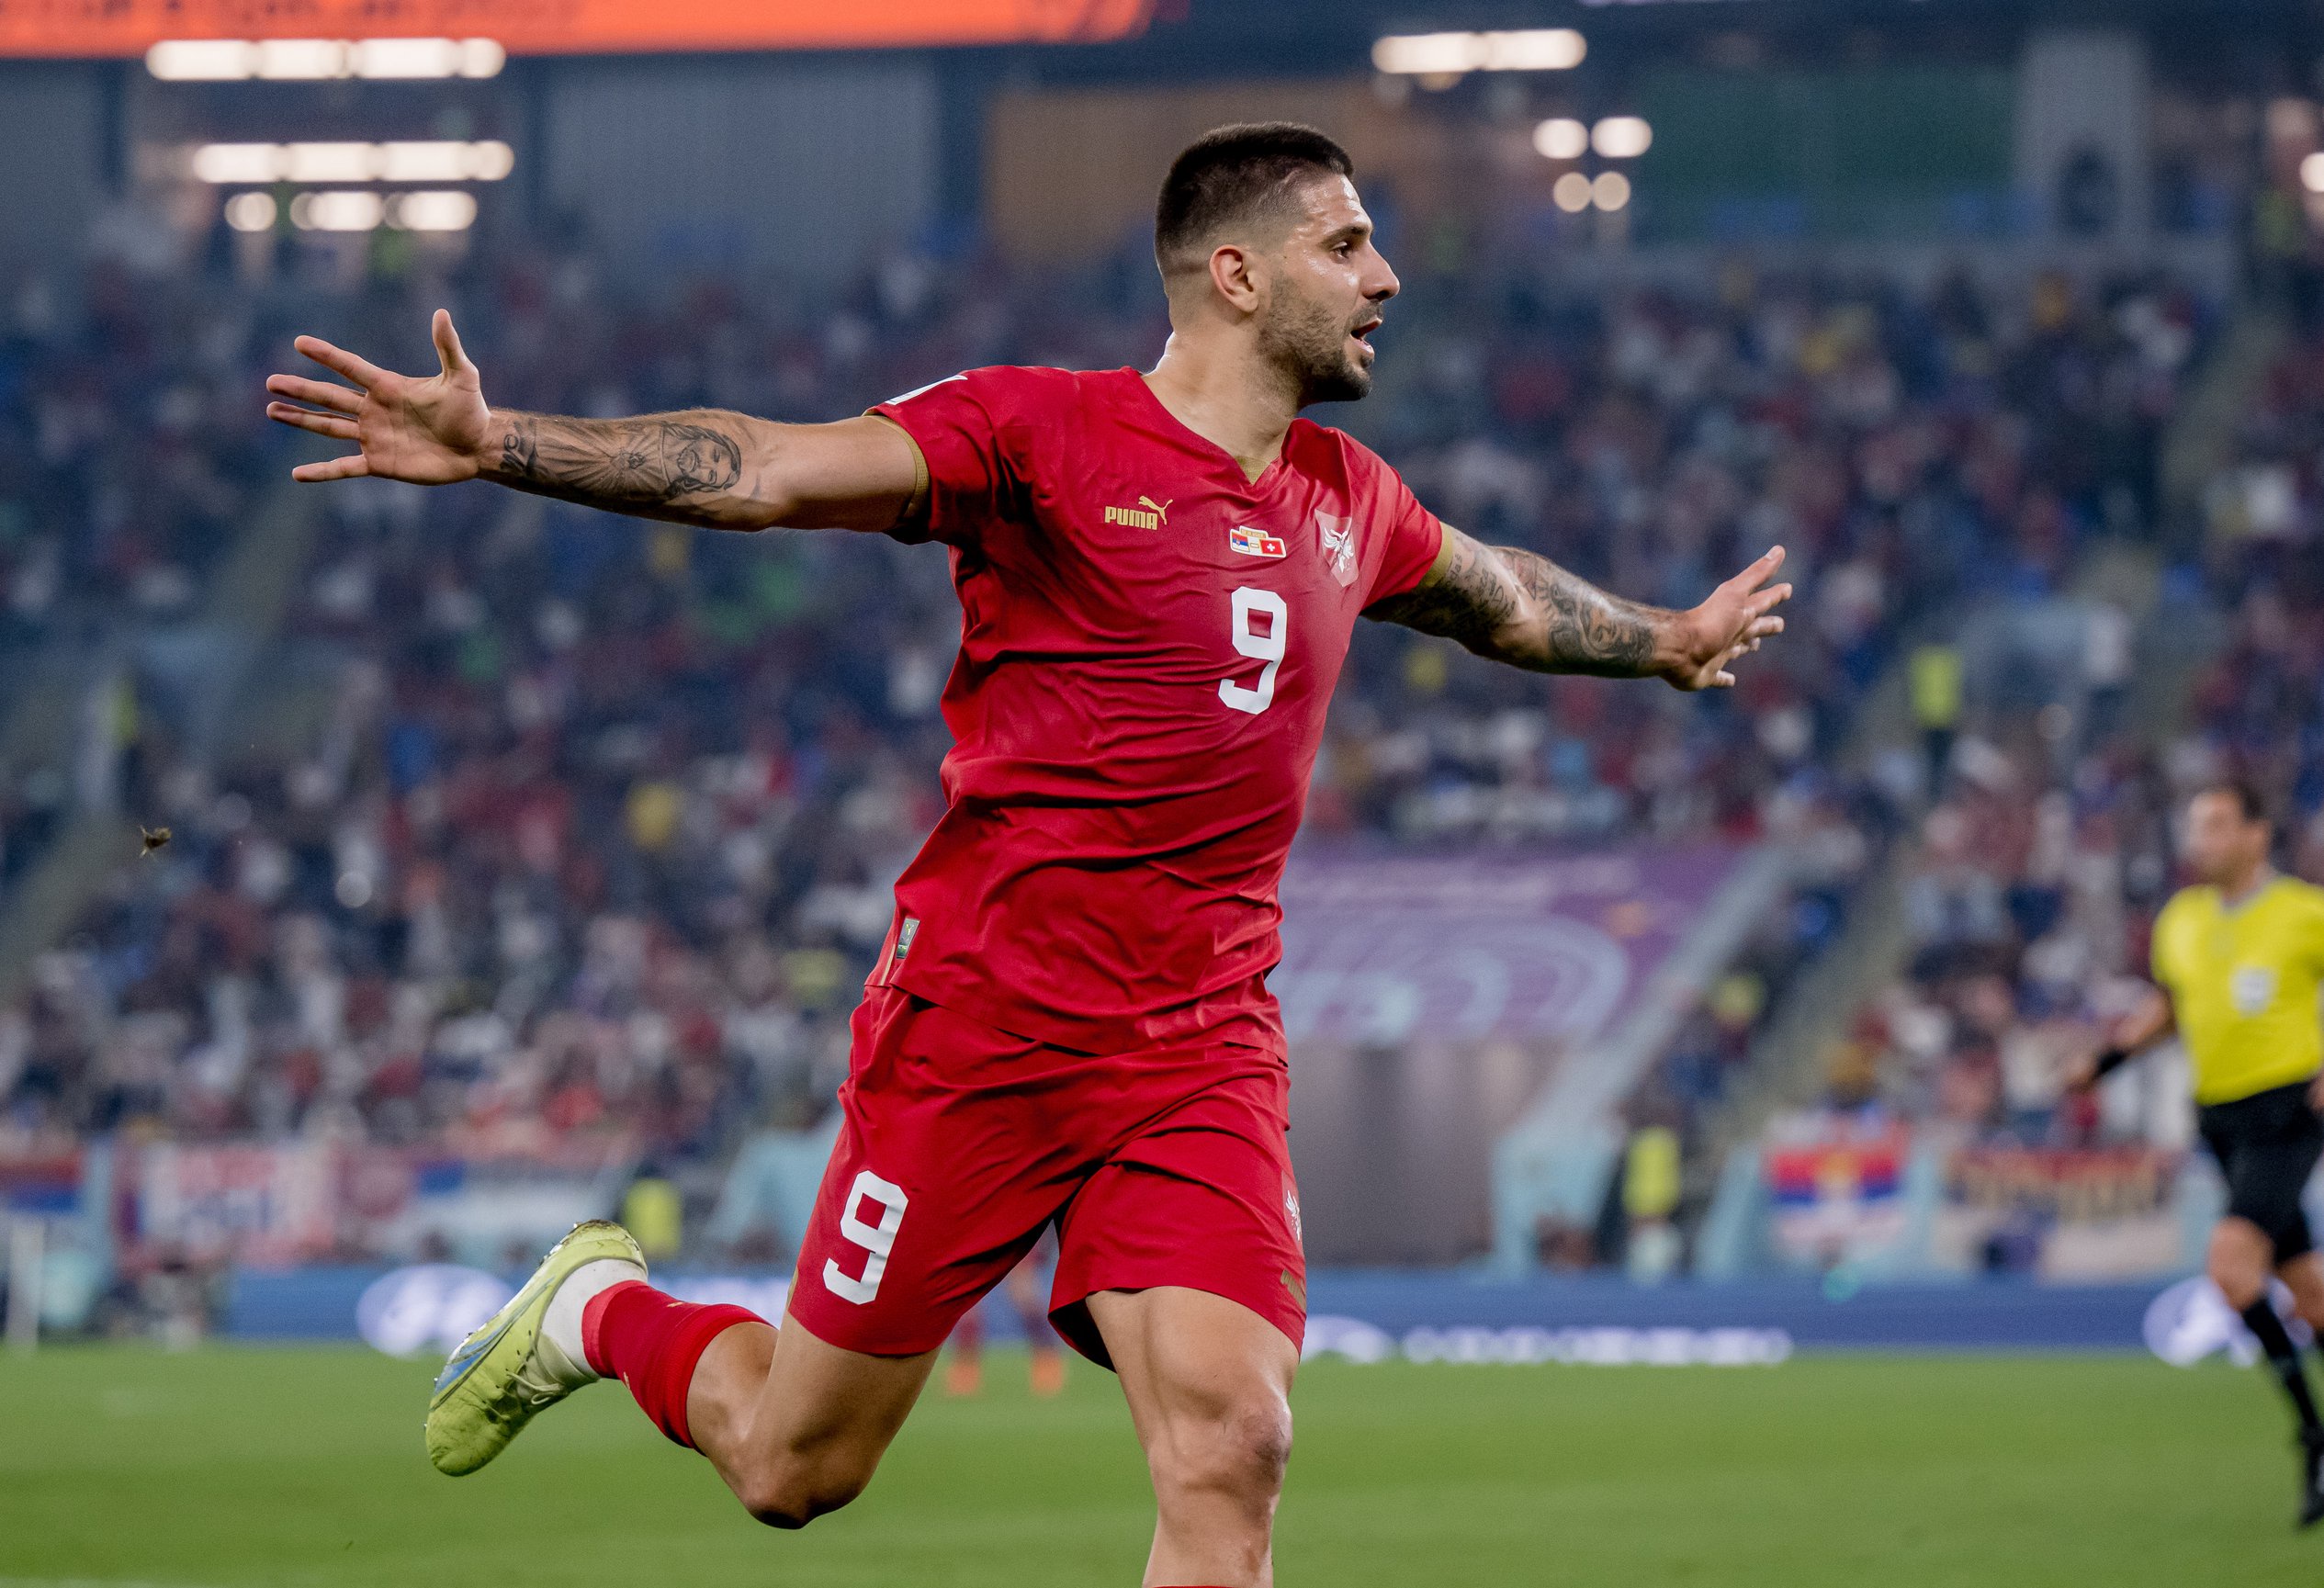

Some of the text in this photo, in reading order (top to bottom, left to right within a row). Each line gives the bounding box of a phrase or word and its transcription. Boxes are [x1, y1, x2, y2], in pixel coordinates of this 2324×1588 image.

[1105, 506, 1157, 531] PUMA
[1218, 586, 1287, 715] 9
[822, 1169, 909, 1305] 9
